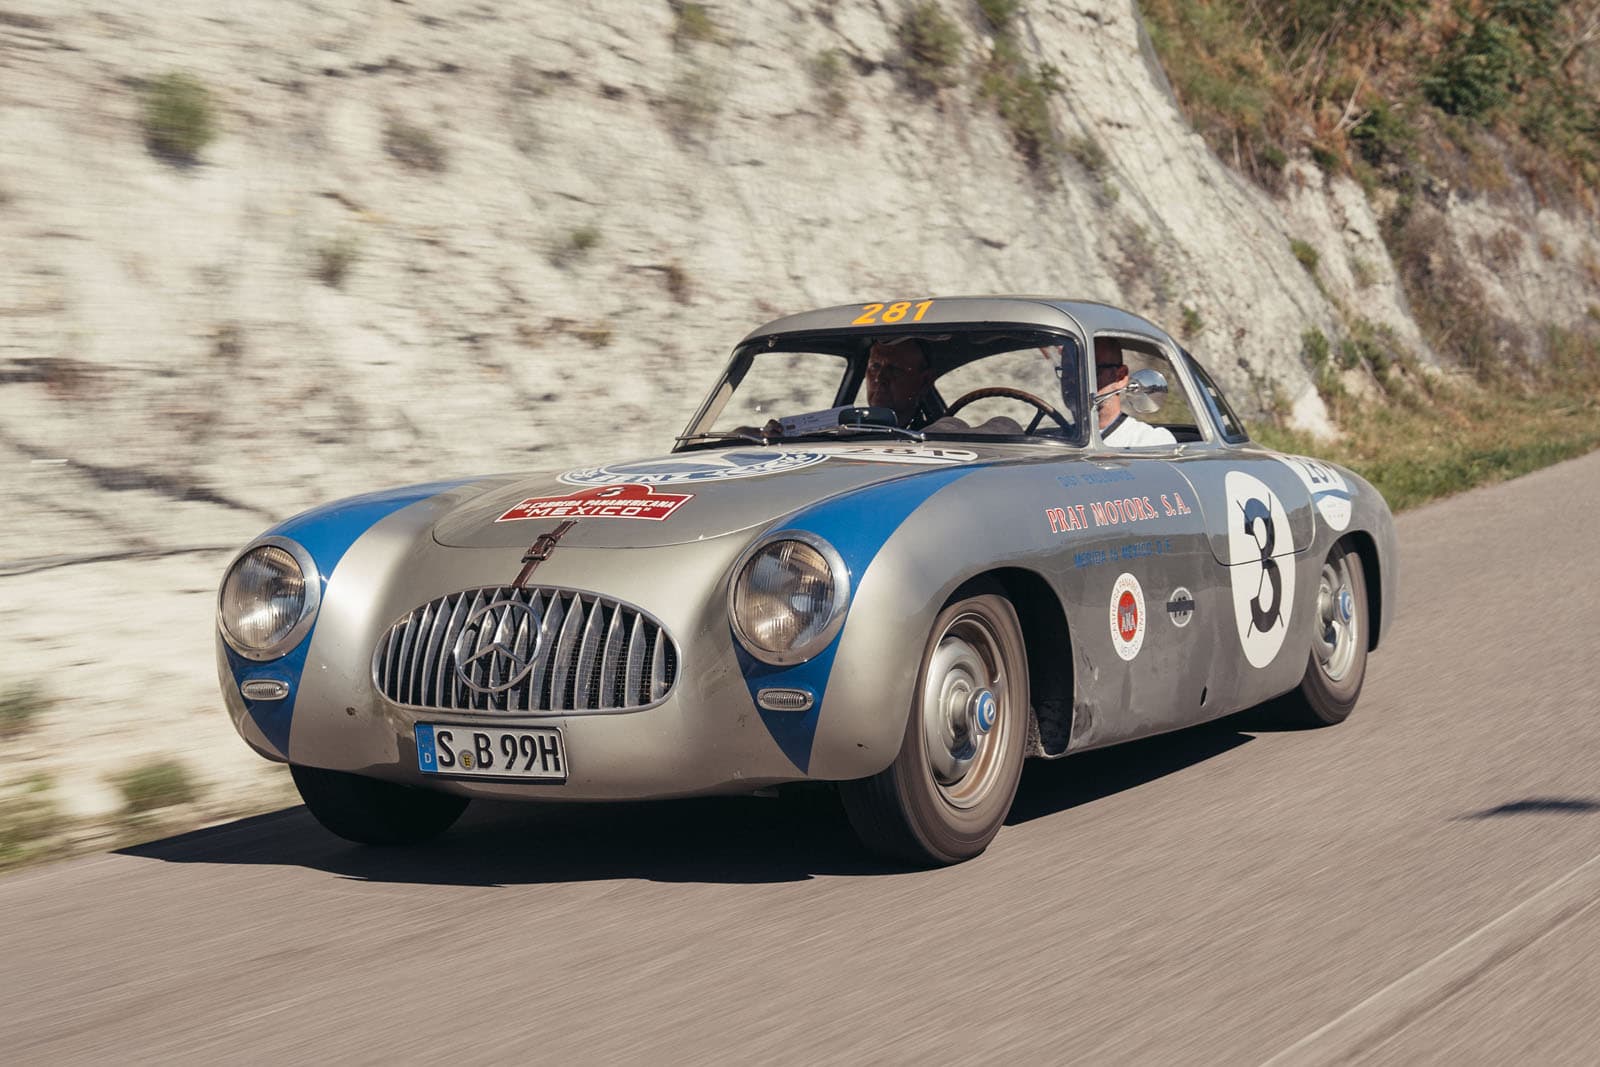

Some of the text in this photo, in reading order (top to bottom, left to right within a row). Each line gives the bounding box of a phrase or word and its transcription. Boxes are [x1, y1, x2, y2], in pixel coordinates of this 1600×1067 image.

[851, 300, 934, 325] 281
[585, 472, 693, 483] BENZ
[530, 500, 586, 509] CARRERA
[584, 498, 676, 508] PANAMERICANA
[1046, 505, 1089, 534] PRAT
[1237, 493, 1284, 638] 3
[424, 752, 432, 764] D
[436, 730, 456, 768] S
